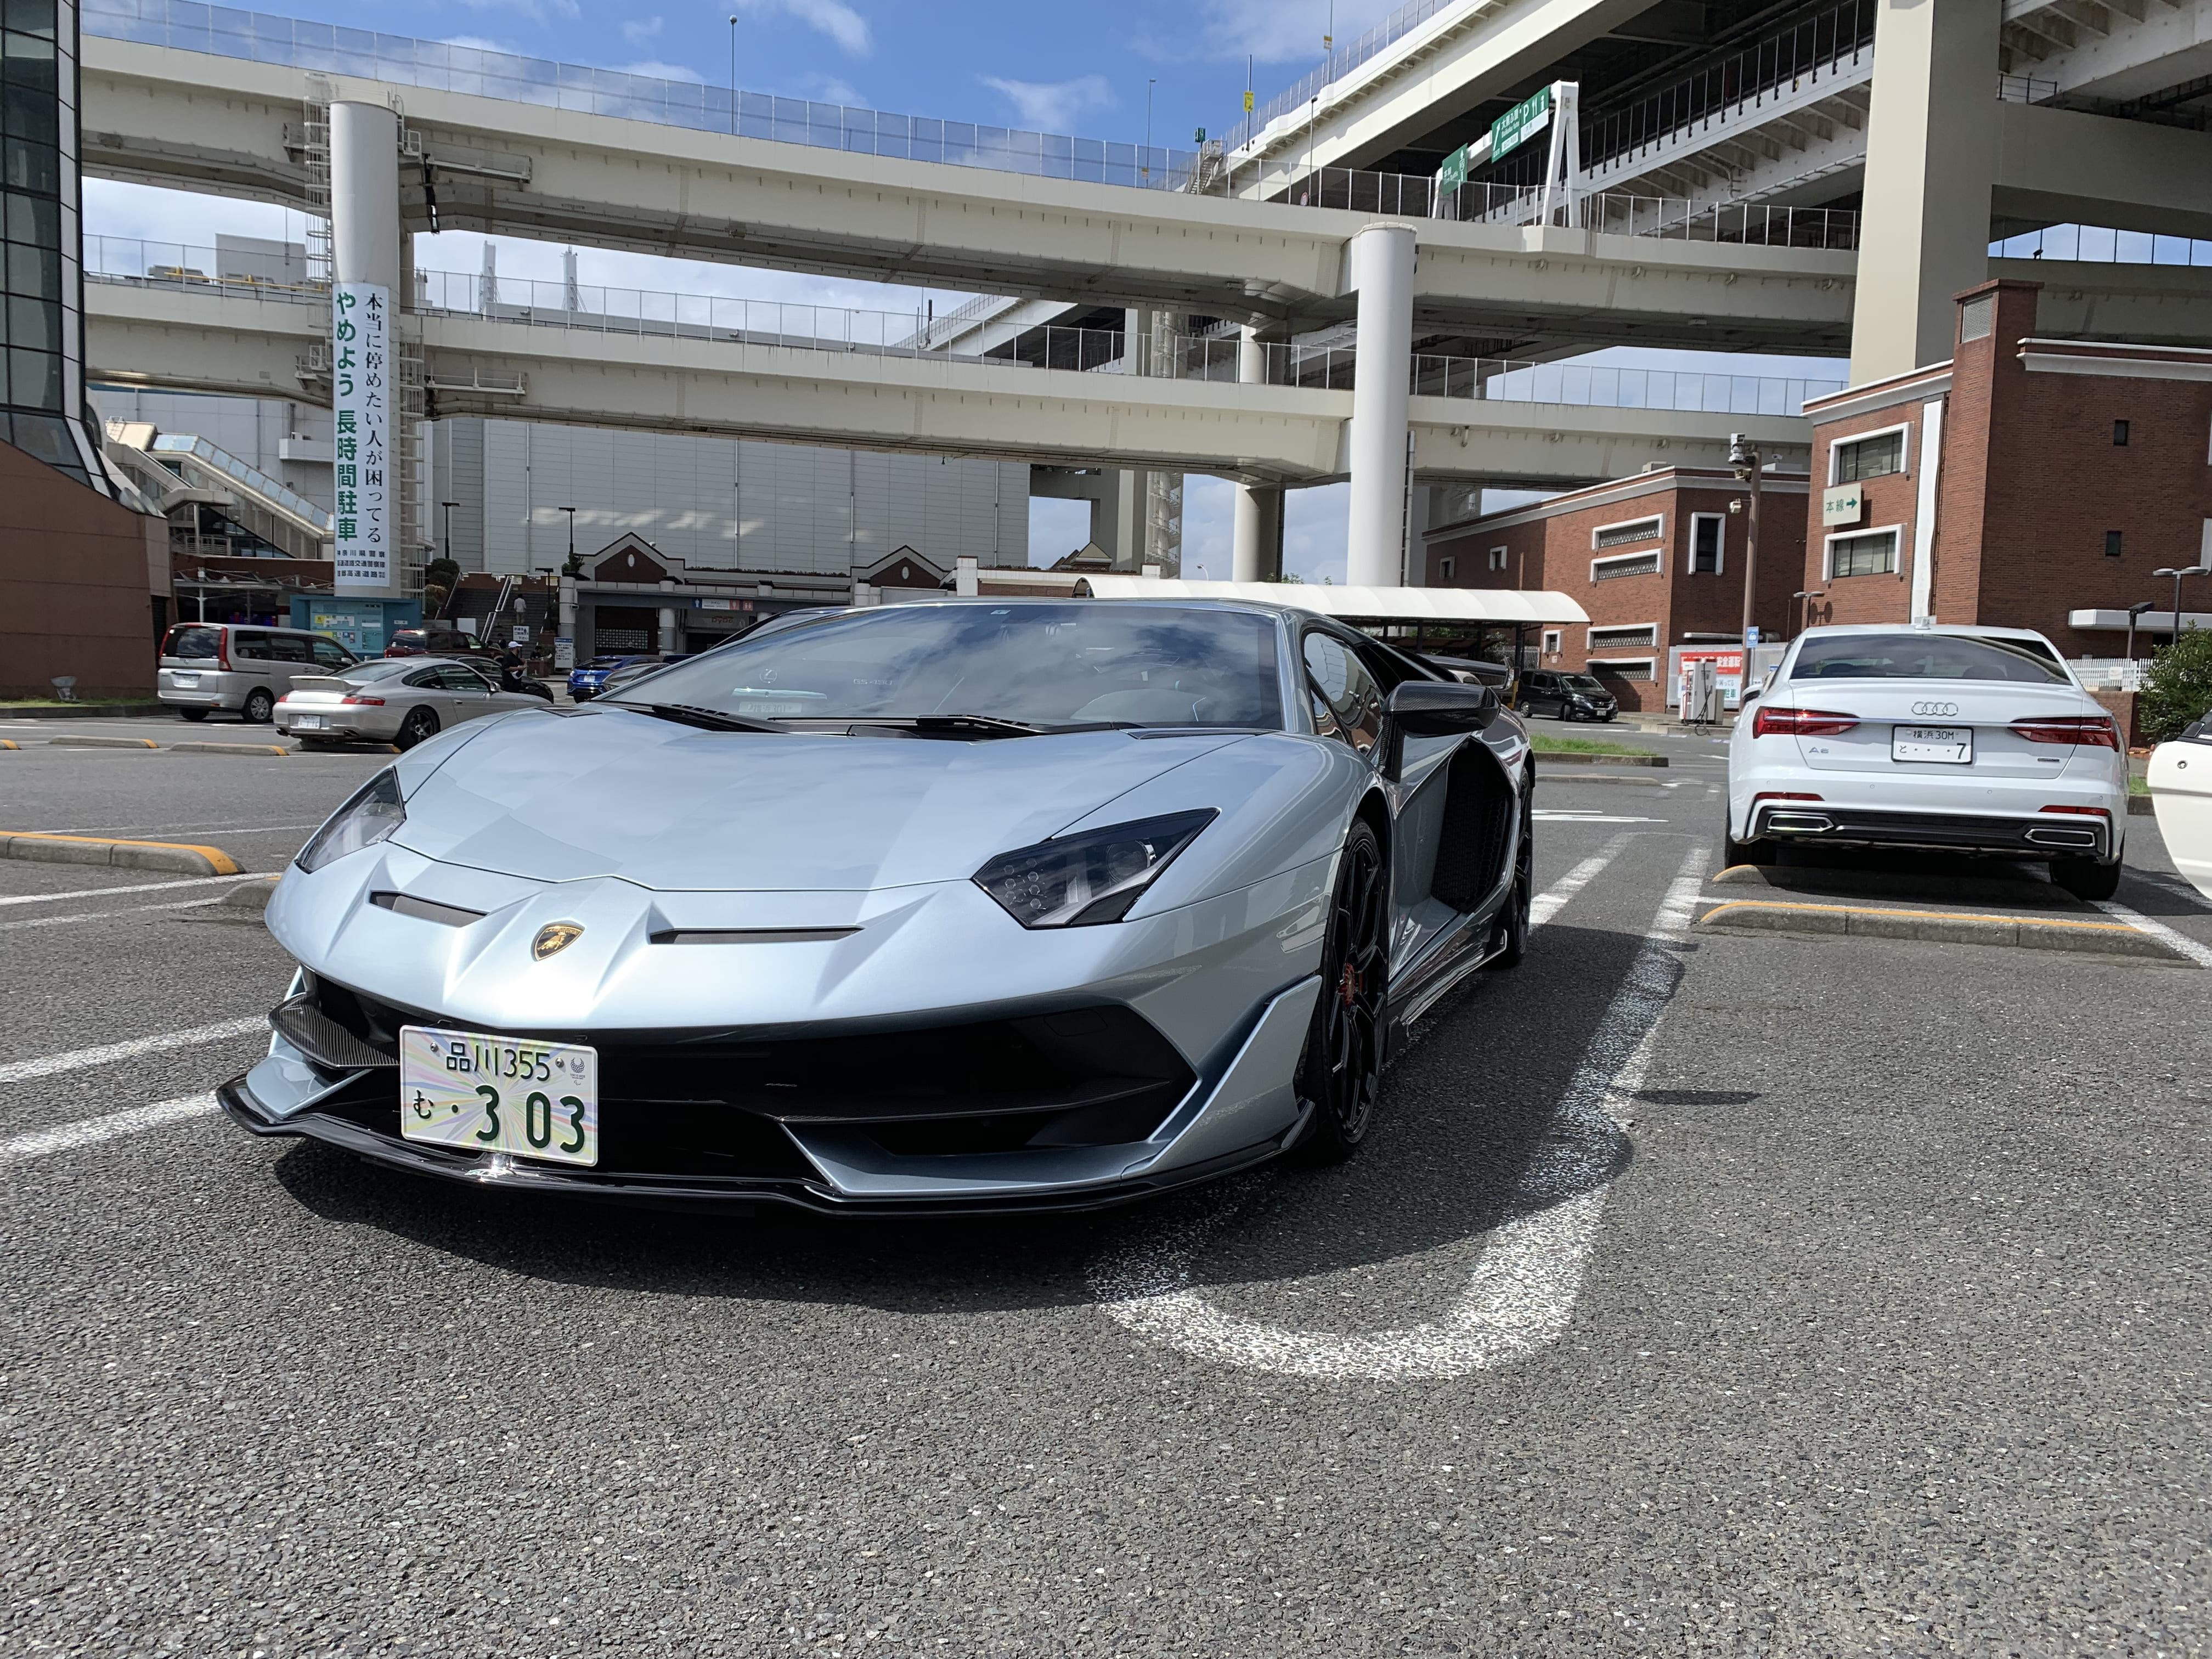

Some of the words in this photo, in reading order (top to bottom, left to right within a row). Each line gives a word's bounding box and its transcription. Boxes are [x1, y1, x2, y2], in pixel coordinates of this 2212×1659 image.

[1523, 104, 1529, 124] P
[336, 292, 357, 397] やめよう
[364, 292, 383, 543] 本当に停めたい人が困ってる
[337, 409, 358, 541] 長時間駐車
[1826, 499, 1844, 514] 本線
[1717, 656, 1742, 667] 安全運転
